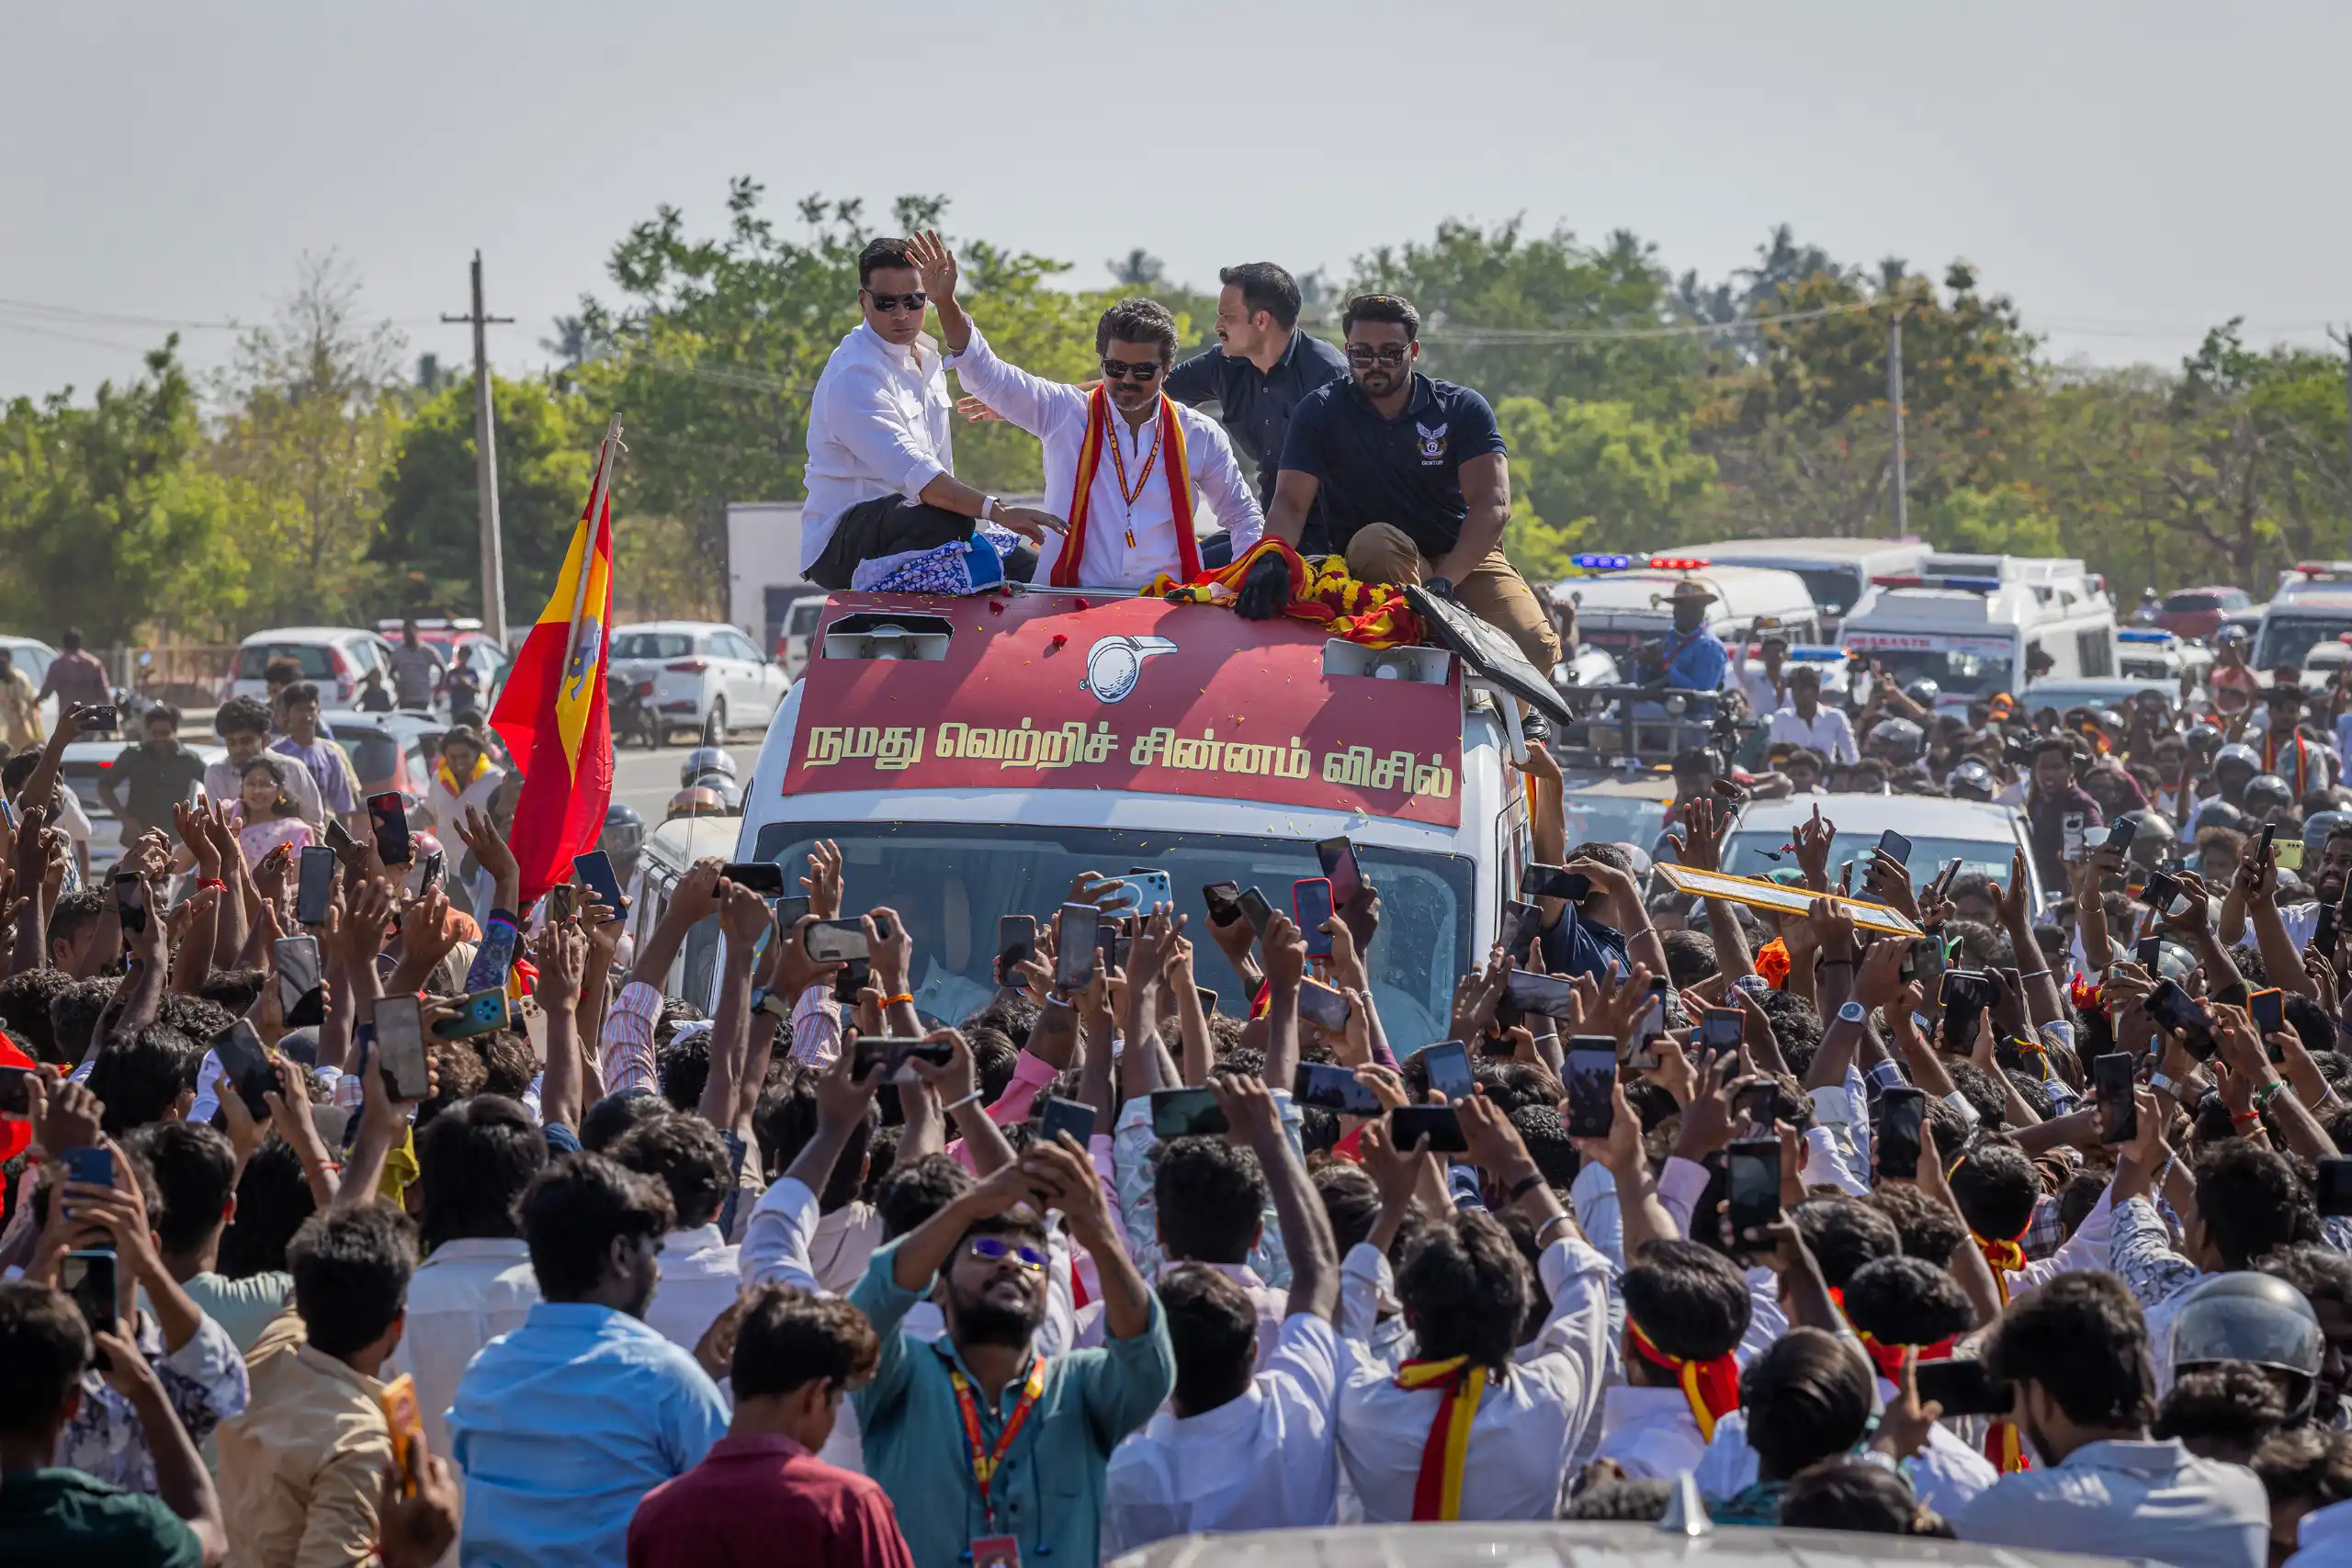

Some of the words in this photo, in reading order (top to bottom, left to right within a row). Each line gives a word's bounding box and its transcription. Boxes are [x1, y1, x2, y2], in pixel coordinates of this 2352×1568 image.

[803, 727, 926, 771] நமது
[935, 716, 1119, 772] வெற்றிச்
[1129, 727, 1312, 779] சின்னம்
[1322, 745, 1453, 798] விசில்
